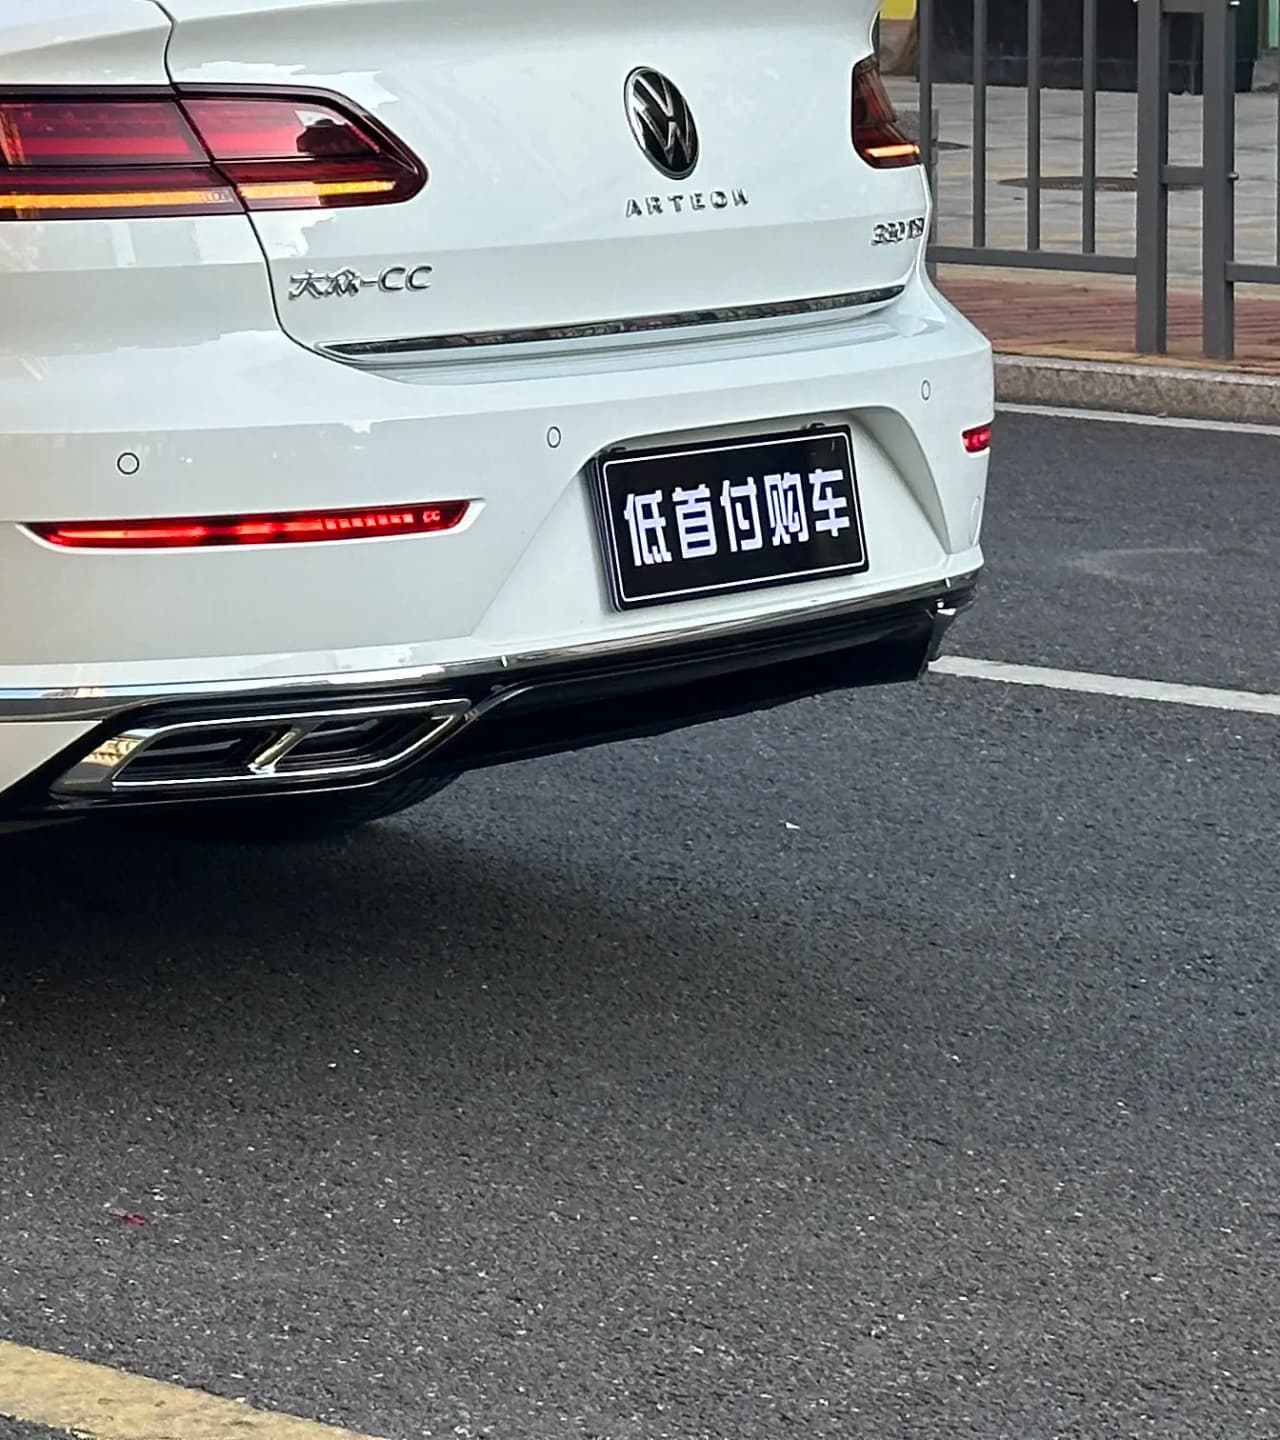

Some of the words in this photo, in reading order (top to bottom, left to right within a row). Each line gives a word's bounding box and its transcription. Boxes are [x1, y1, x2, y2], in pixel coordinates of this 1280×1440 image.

[625, 188, 750, 218] ARTEON
[624, 469, 850, 567] 低首付购车
